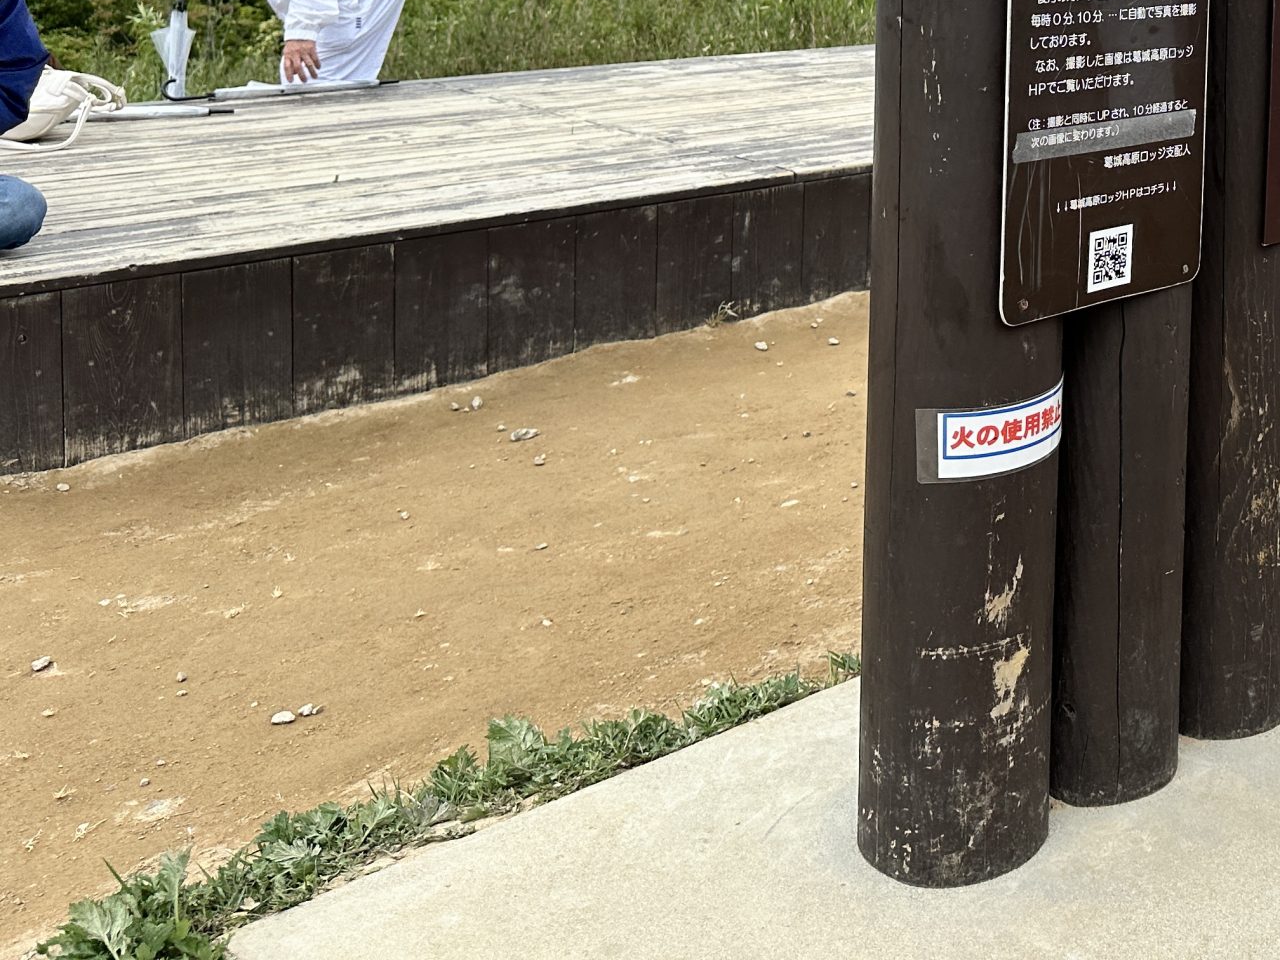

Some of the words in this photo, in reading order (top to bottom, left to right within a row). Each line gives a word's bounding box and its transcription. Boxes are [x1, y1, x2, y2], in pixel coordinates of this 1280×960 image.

[1030, 33, 1091, 50] しております。
[1028, 72, 1135, 96] HPでご覧いただけます。
